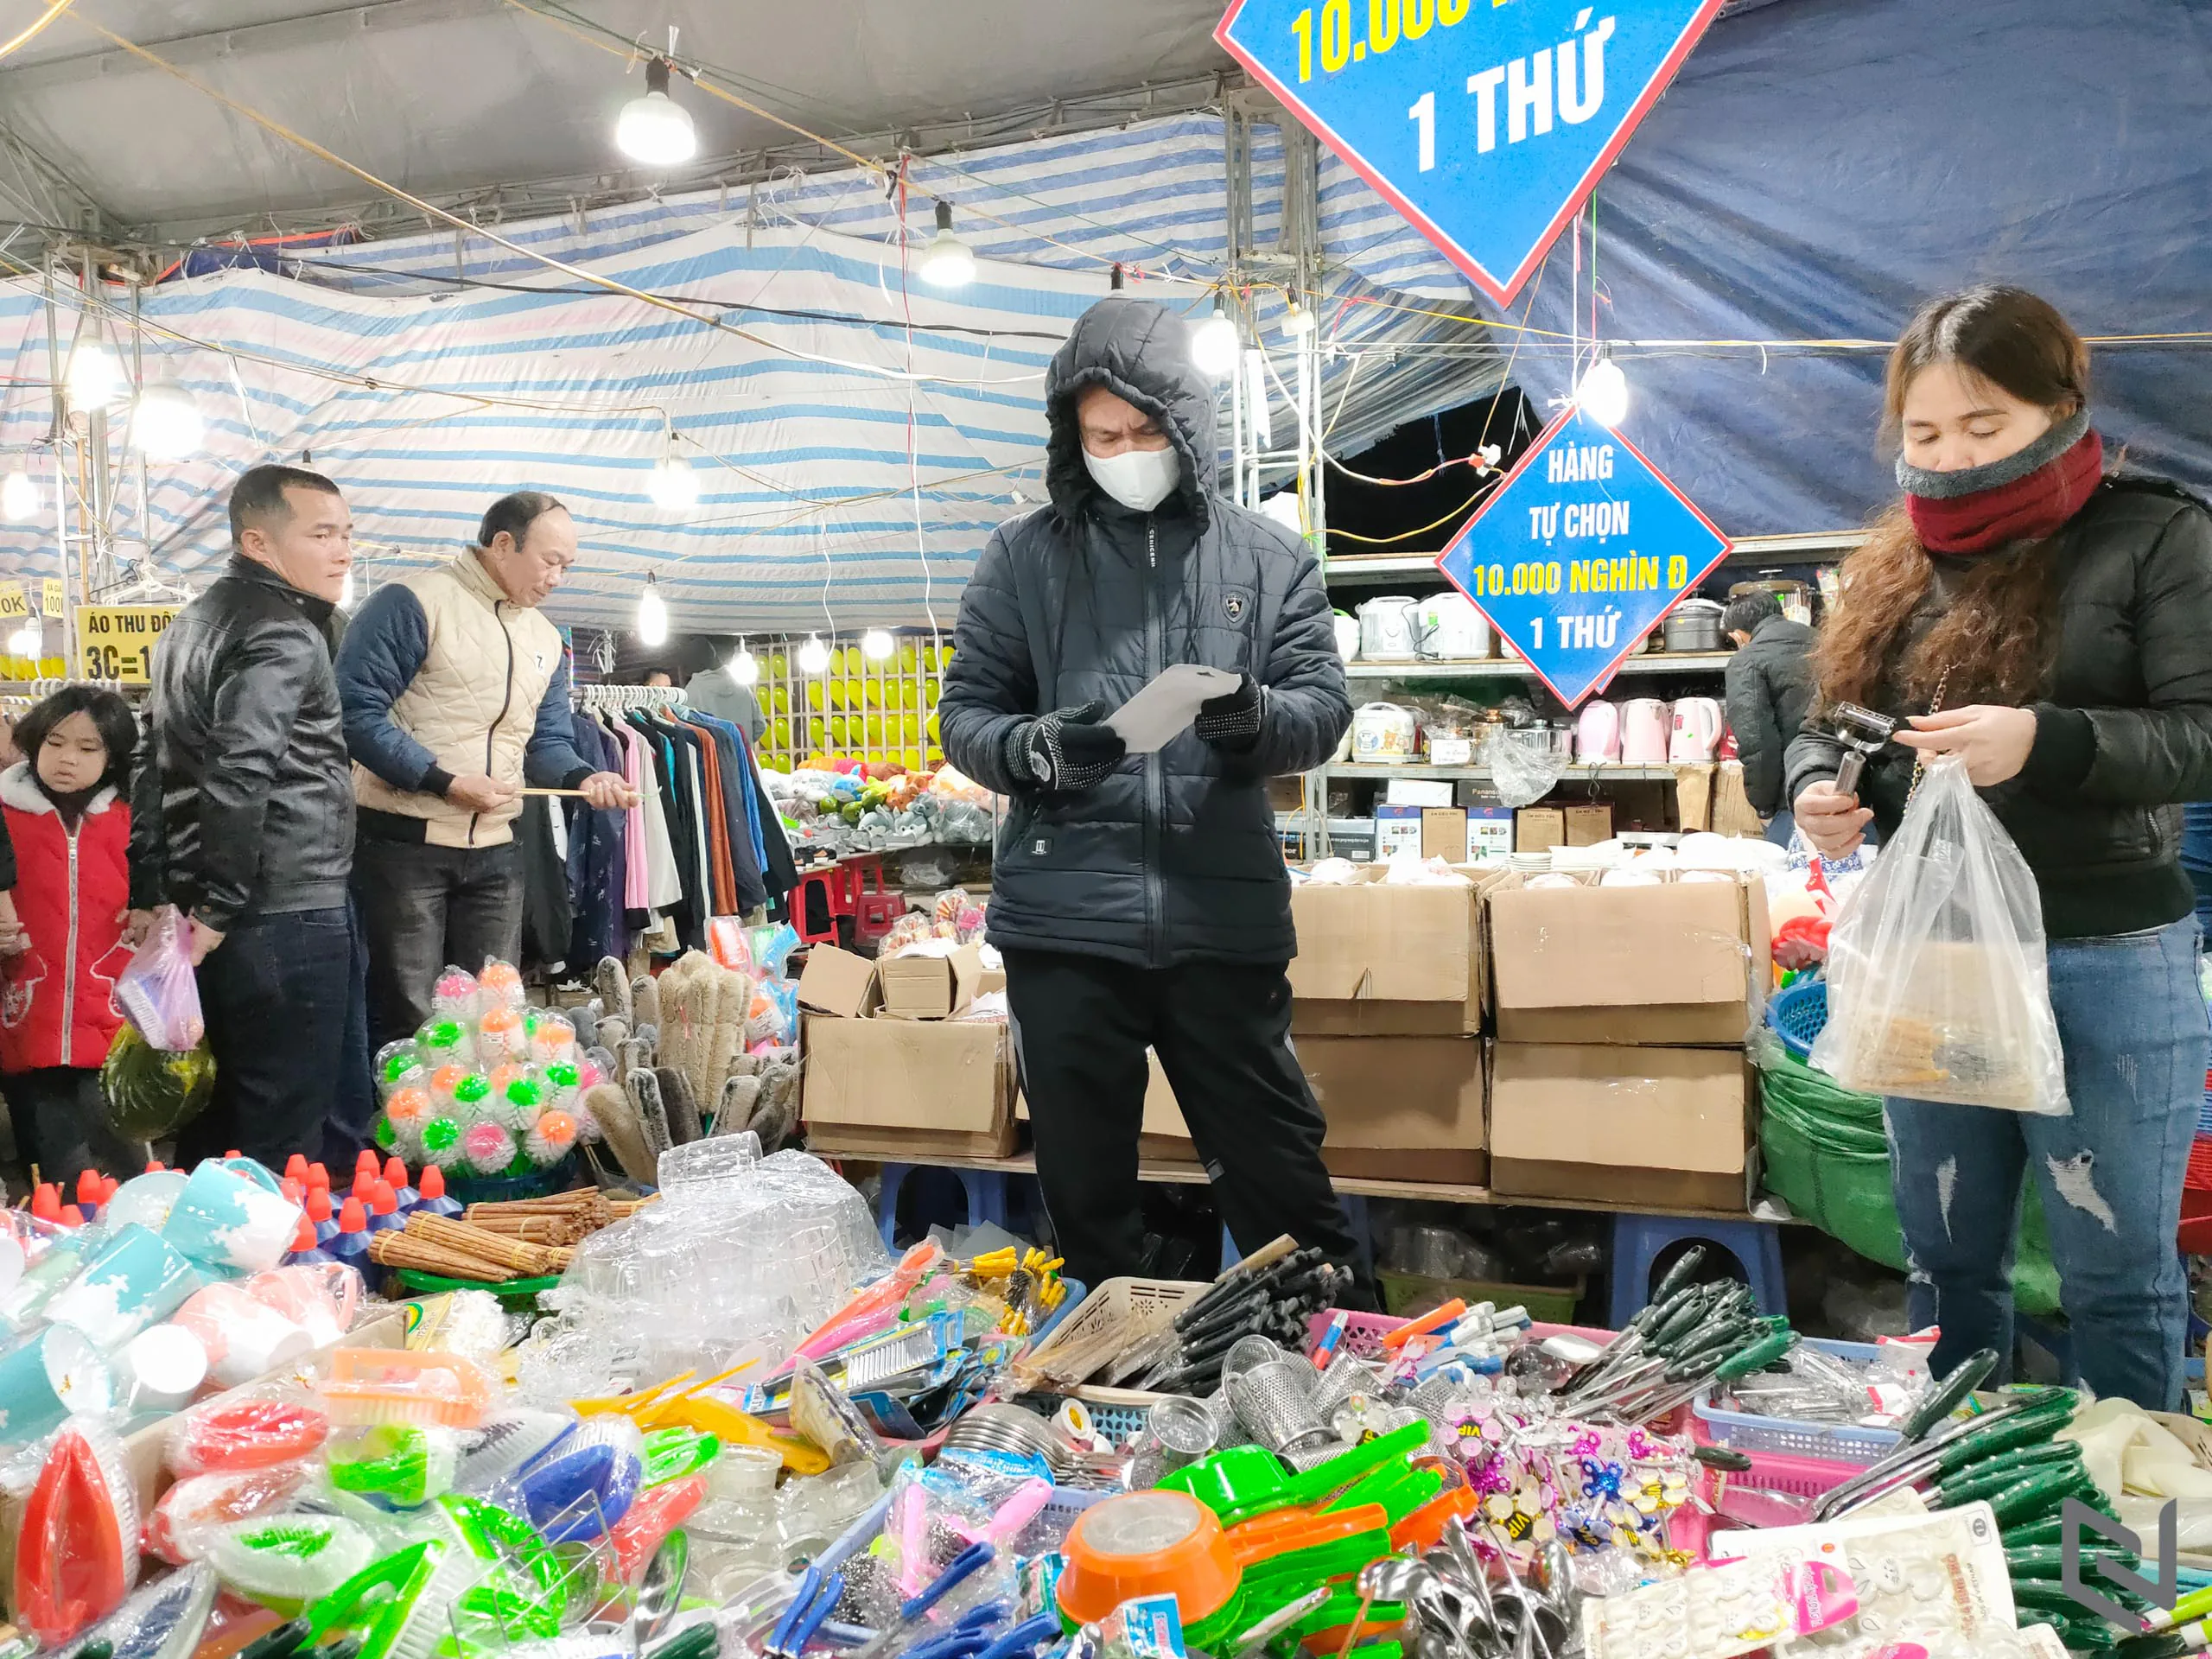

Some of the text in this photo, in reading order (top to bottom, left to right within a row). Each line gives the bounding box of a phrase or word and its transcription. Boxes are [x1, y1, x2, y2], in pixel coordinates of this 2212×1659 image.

[1408, 7, 1616, 173] 1 THỨ
[1548, 441, 1614, 483] HÀNG
[1529, 500, 1630, 547] TỰ CHỌN
[1473, 550, 1688, 596] 10.000 NGHÌN Đ
[45, 594, 64, 613] 100
[88, 611, 176, 633] ÁO THU ĐÔ
[1529, 605, 1622, 650] 1 THỨ
[1458, 1424, 1481, 1437] VIP
[1508, 1512, 1530, 1539] VIP
